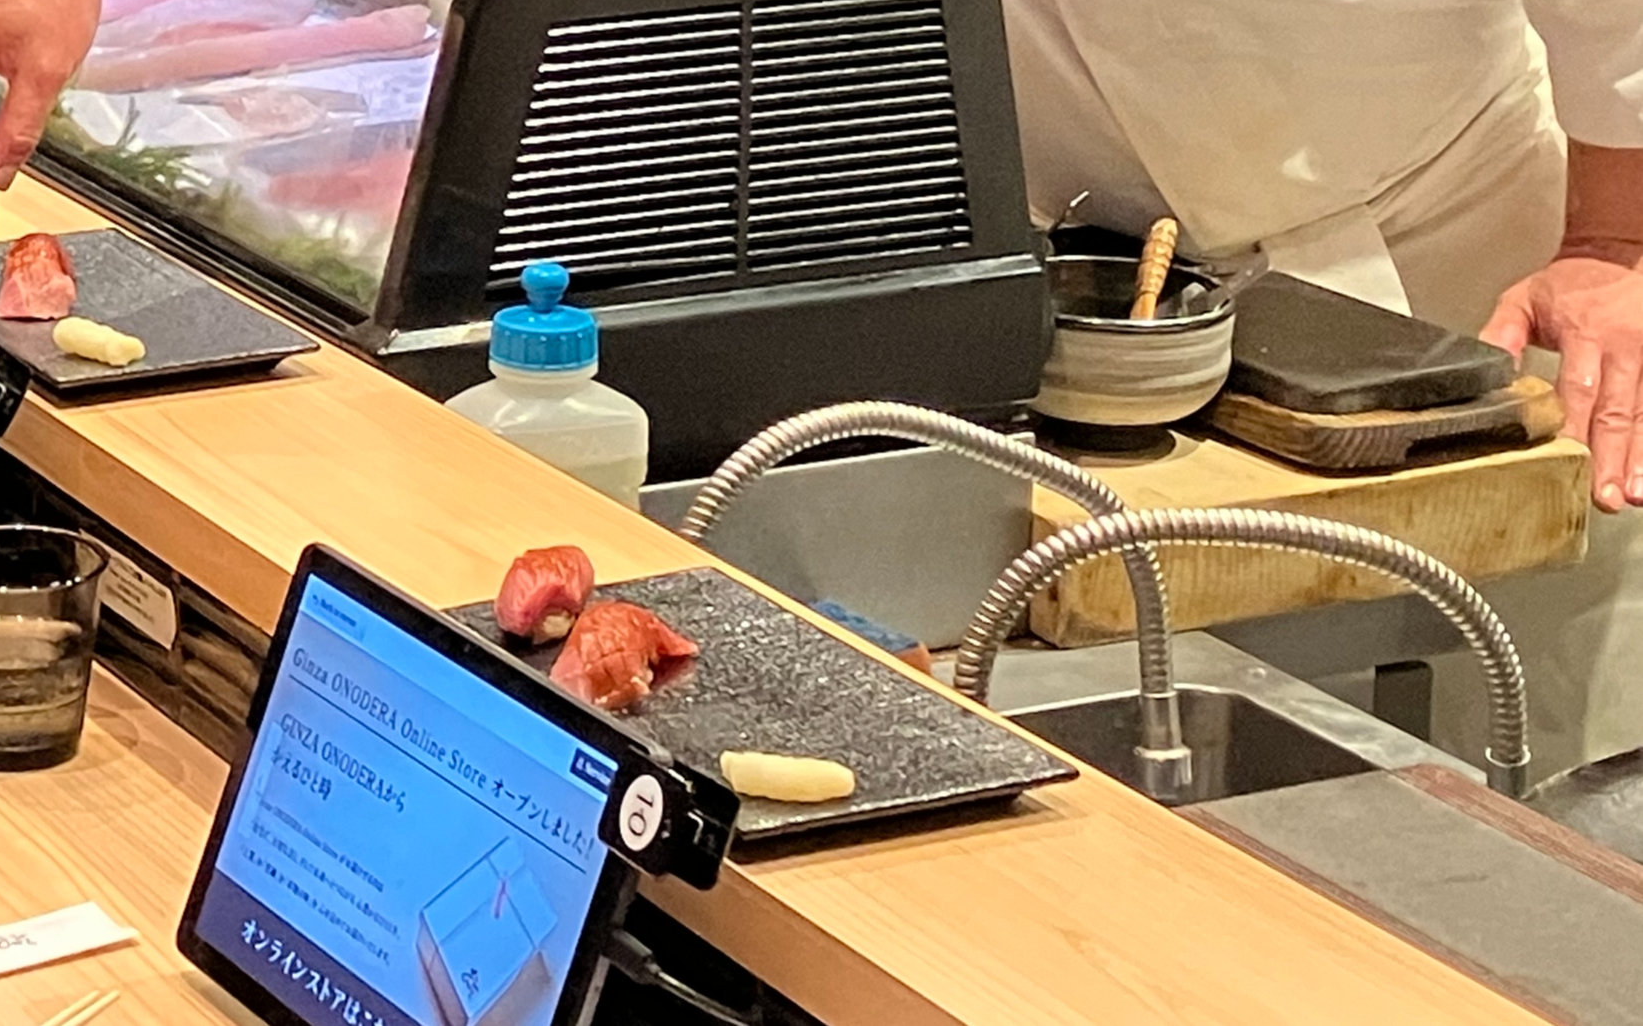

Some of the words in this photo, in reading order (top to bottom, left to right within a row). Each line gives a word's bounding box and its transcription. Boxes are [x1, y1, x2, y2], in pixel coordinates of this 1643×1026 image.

[280, 713, 320, 755] GINZA
[292, 647, 329, 685] Ginza
[330, 672, 398, 732] ONODERA
[400, 717, 446, 763] Online
[447, 749, 488, 789] Store
[627, 793, 655, 838] 10
